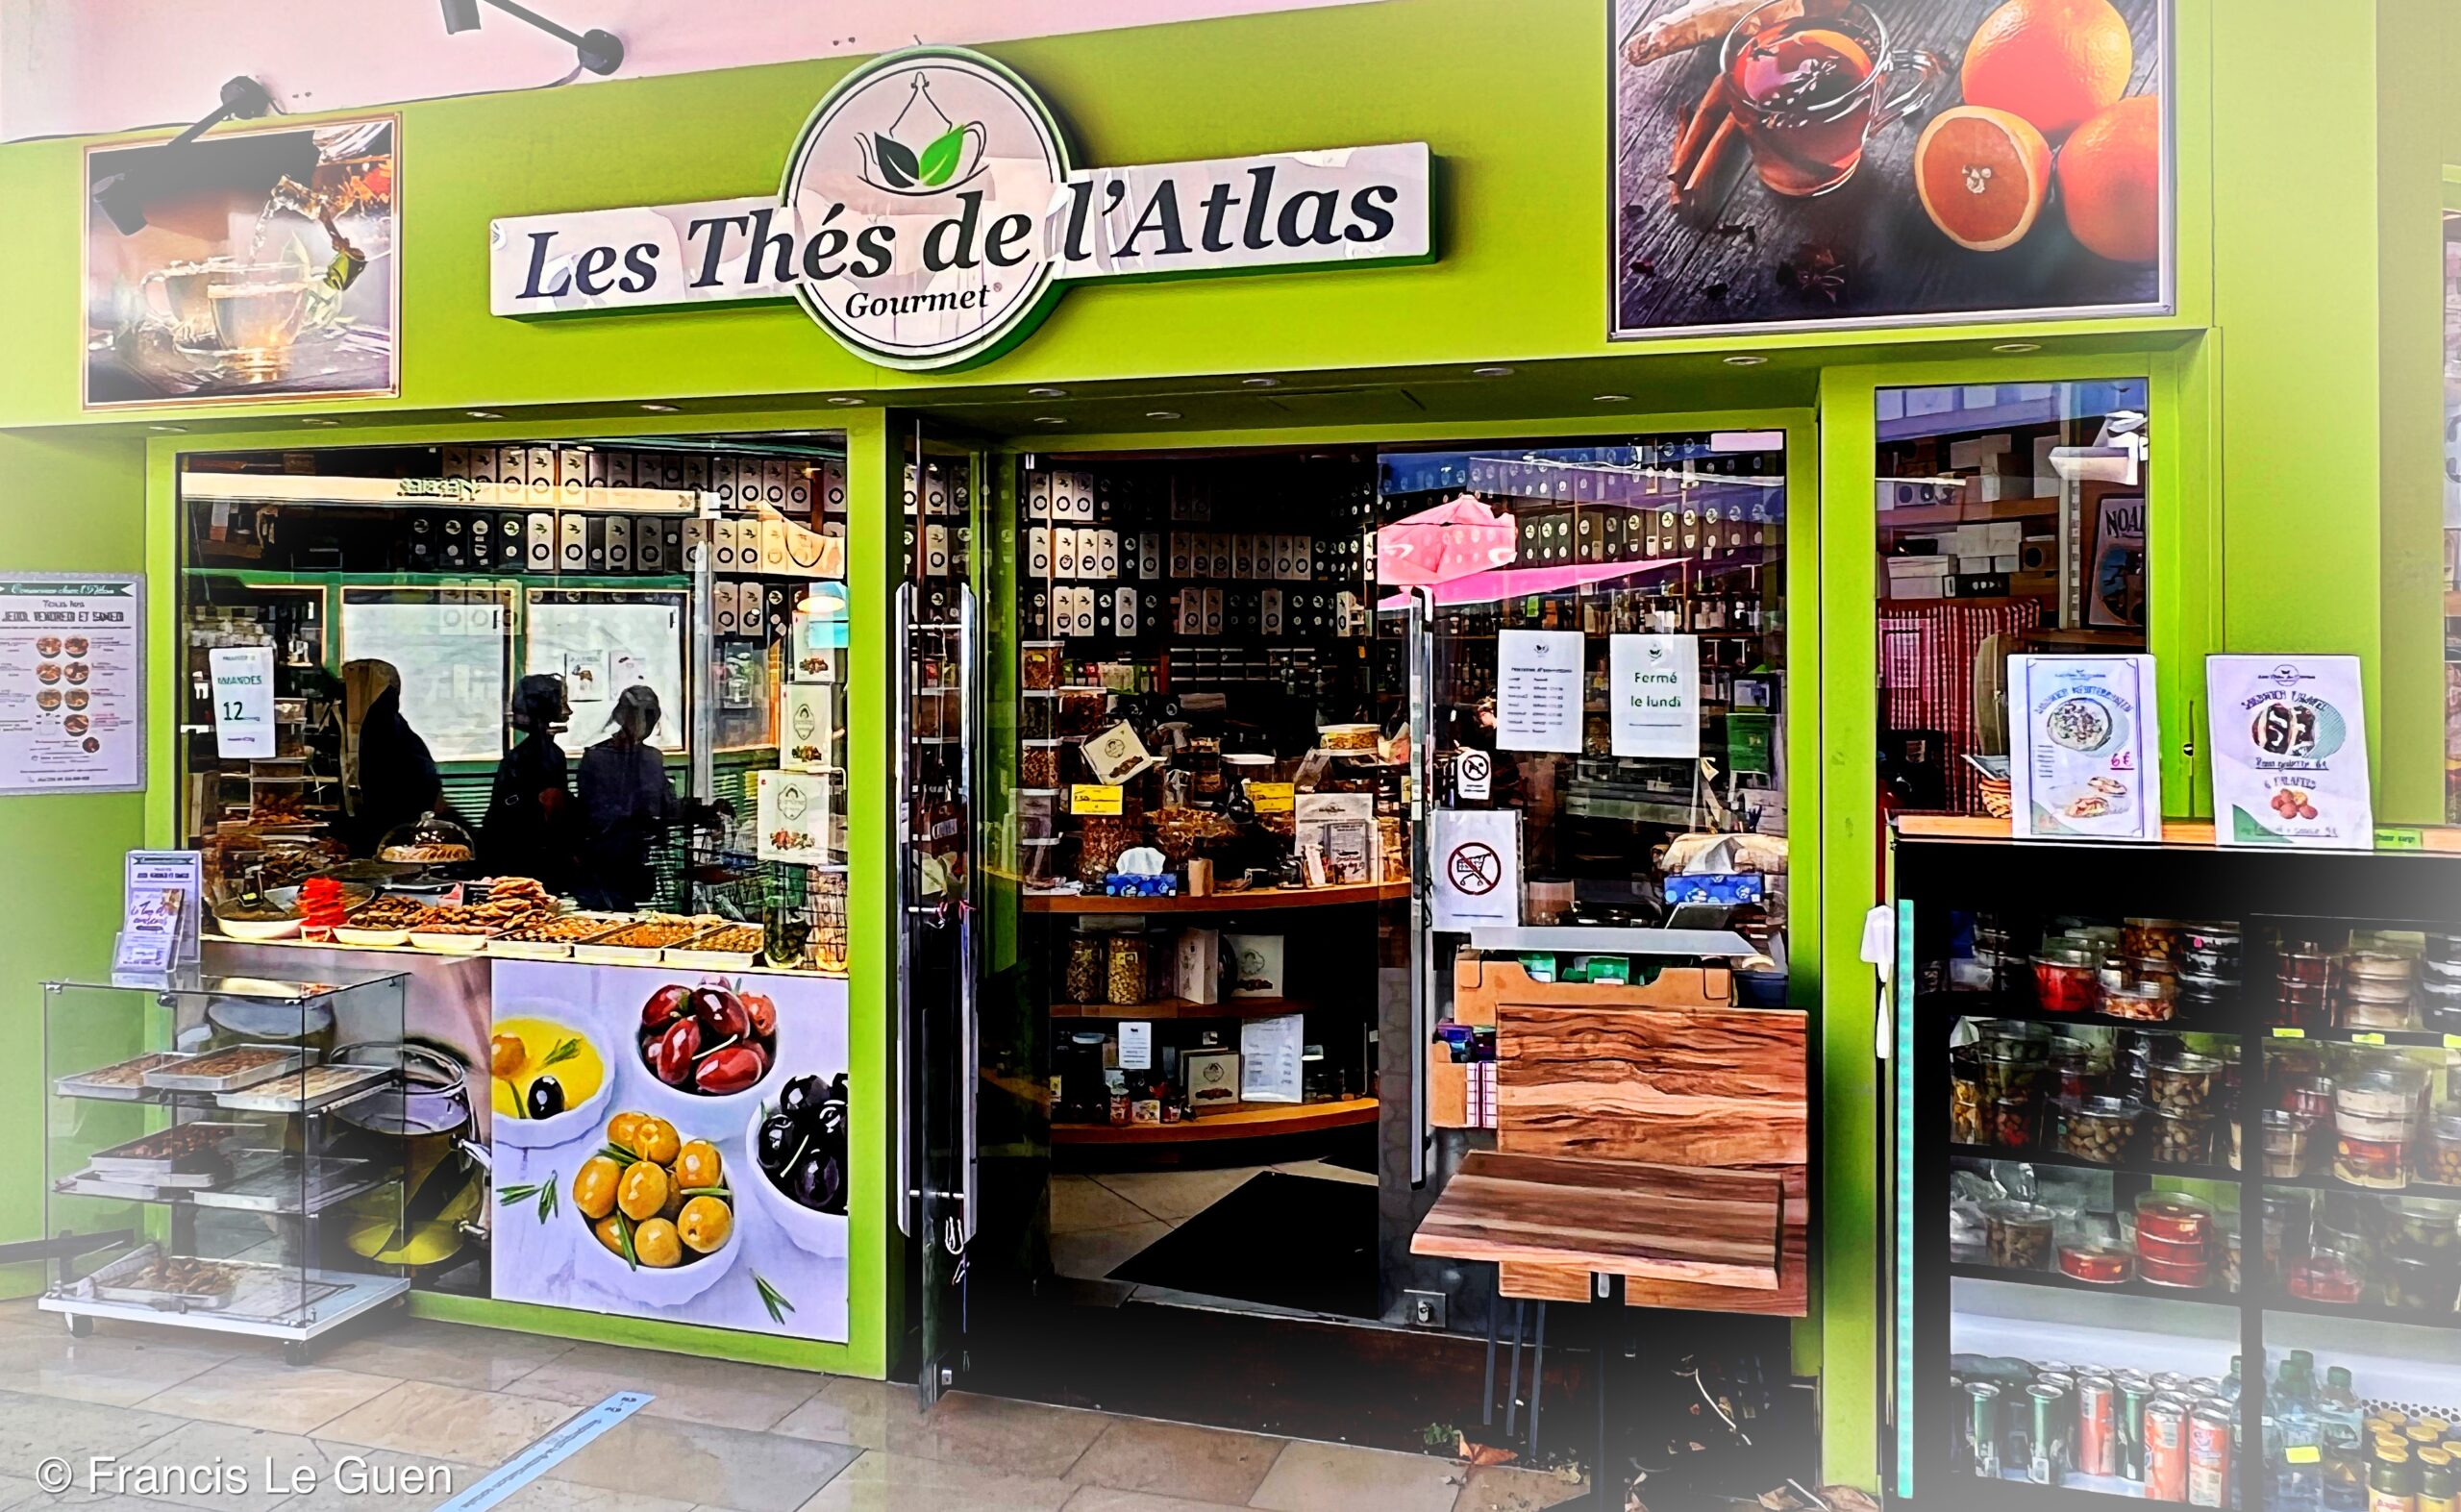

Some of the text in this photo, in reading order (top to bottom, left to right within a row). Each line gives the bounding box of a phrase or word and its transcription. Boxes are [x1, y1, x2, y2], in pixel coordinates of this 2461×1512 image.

[516, 231, 660, 301] Les
[684, 200, 898, 288] Thés
[921, 189, 1032, 271] de
[845, 284, 991, 319] Gourmet
[1634, 671, 1678, 684] Fermé
[223, 701, 244, 721] 12
[1630, 695, 1681, 707] le lundi
